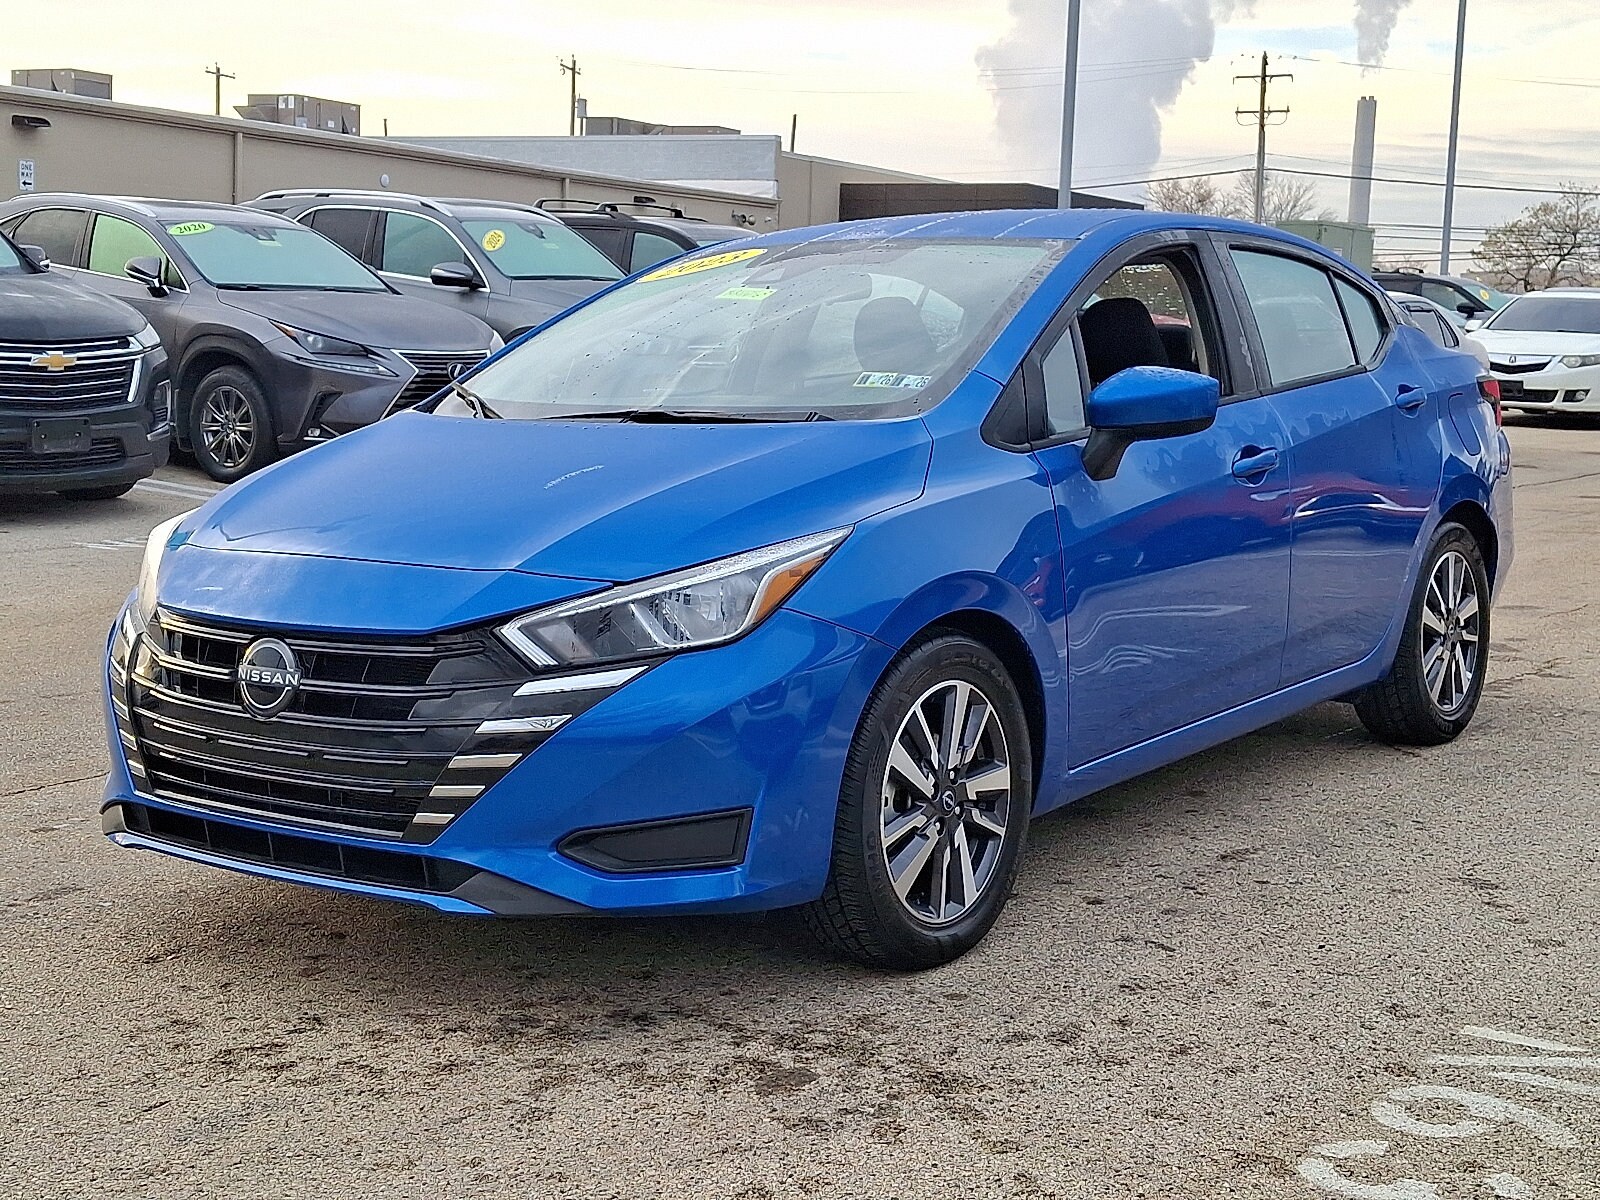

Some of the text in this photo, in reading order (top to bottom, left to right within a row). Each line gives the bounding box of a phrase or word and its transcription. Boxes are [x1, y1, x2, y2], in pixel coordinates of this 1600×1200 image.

[21, 163, 32, 171] ONE
[176, 223, 206, 234] 2020
[486, 231, 502, 249] 2024
[238, 668, 298, 685] NISSAN
